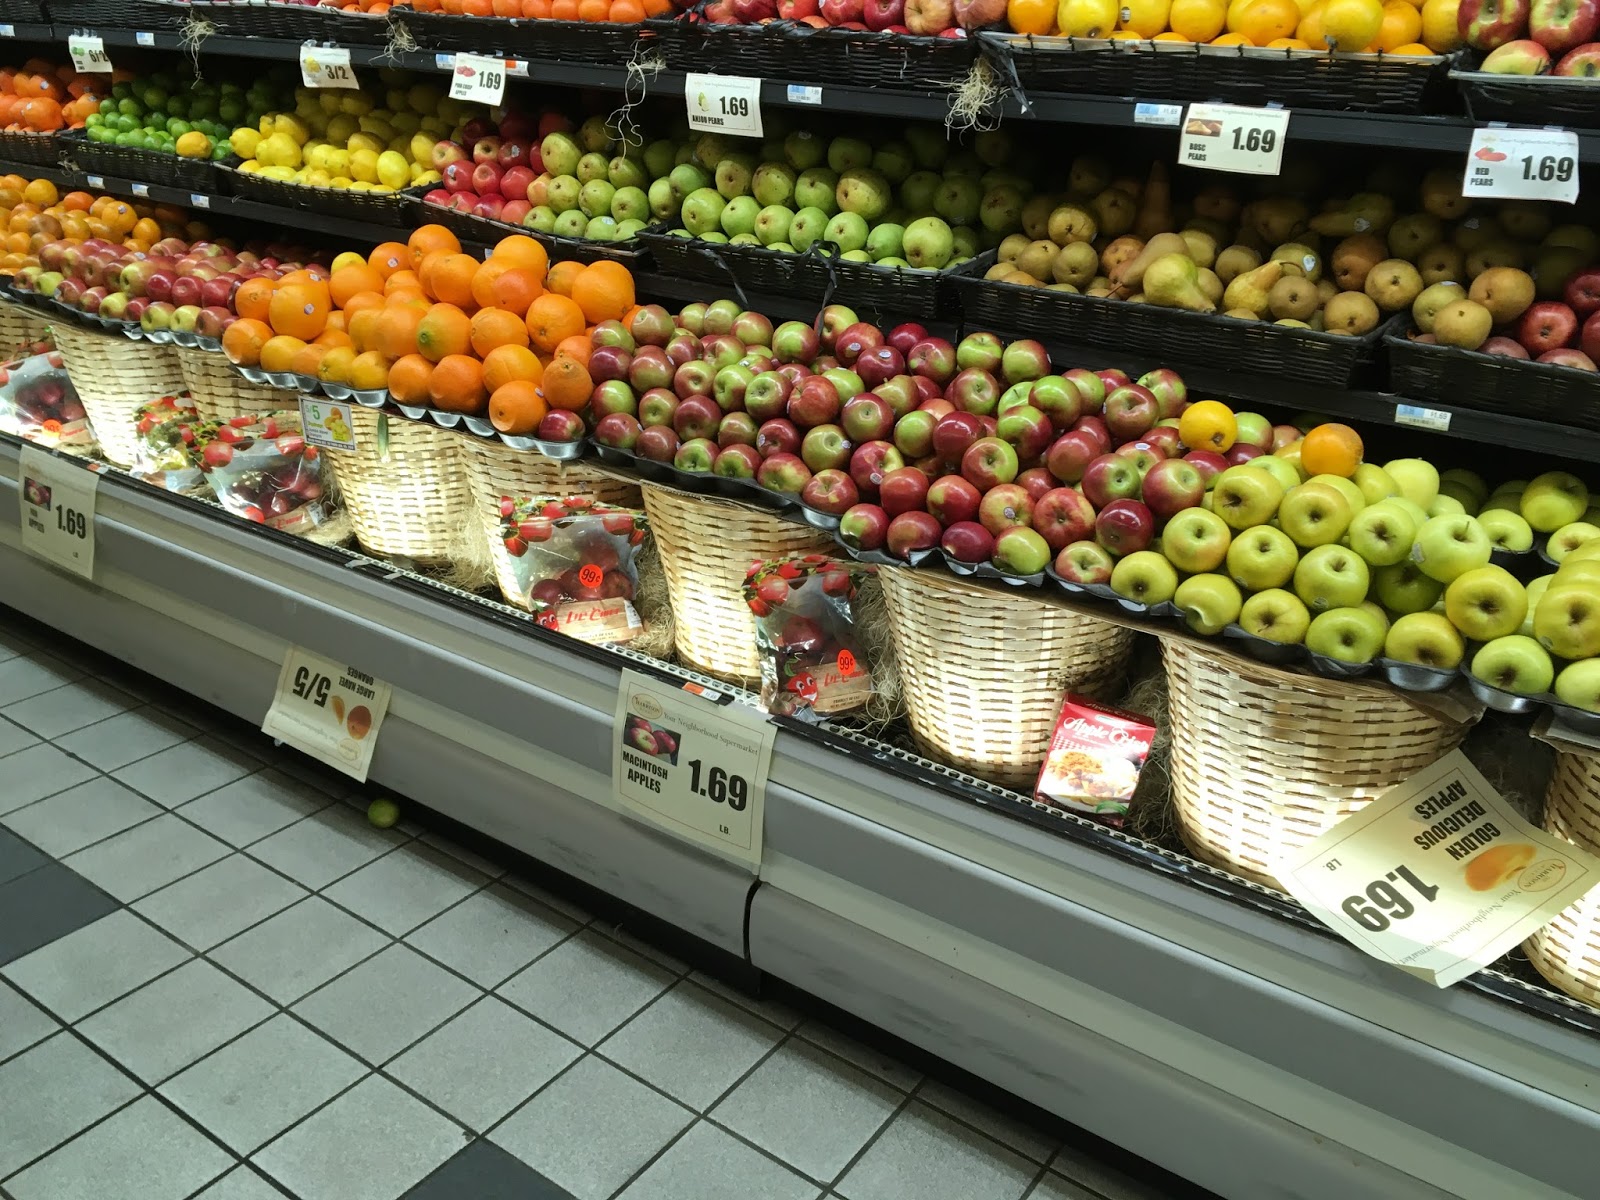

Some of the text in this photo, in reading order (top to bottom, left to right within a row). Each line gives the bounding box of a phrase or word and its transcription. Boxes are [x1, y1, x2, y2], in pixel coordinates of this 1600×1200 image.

[325, 64, 349, 80] 3/2
[478, 71, 502, 90] 1.69
[719, 96, 748, 117] 1.69
[708, 117, 724, 125] PEARS
[1189, 143, 1206, 151] BOSC
[1232, 127, 1276, 153] 1.69
[1188, 152, 1207, 161] PEARS
[1521, 155, 1574, 182] 1.69
[1470, 178, 1494, 187] PEARS
[1475, 167, 1490, 175] RED
[56, 504, 86, 539] 1.69
[292, 666, 331, 708] 5/5
[338, 675, 376, 701] LARGE NAVEL
[347, 666, 374, 686] ORANGES
[663, 711, 676, 722] Your
[677, 717, 719, 740] Neighborhood
[719, 734, 758, 756] Supermarket
[1063, 717, 1109, 739] Apple
[622, 751, 668, 780] MACINTOSH
[627, 768, 661, 794] APPLES
[688, 758, 748, 812] 1.69
[1414, 780, 1468, 819] APPLES
[1413, 800, 1487, 850] DELICIOUS
[1444, 822, 1501, 861] GOLDEN
[1341, 864, 1440, 933] 1.69
[1500, 889, 1521, 903] Your
[1449, 902, 1503, 942] Neighborhood
